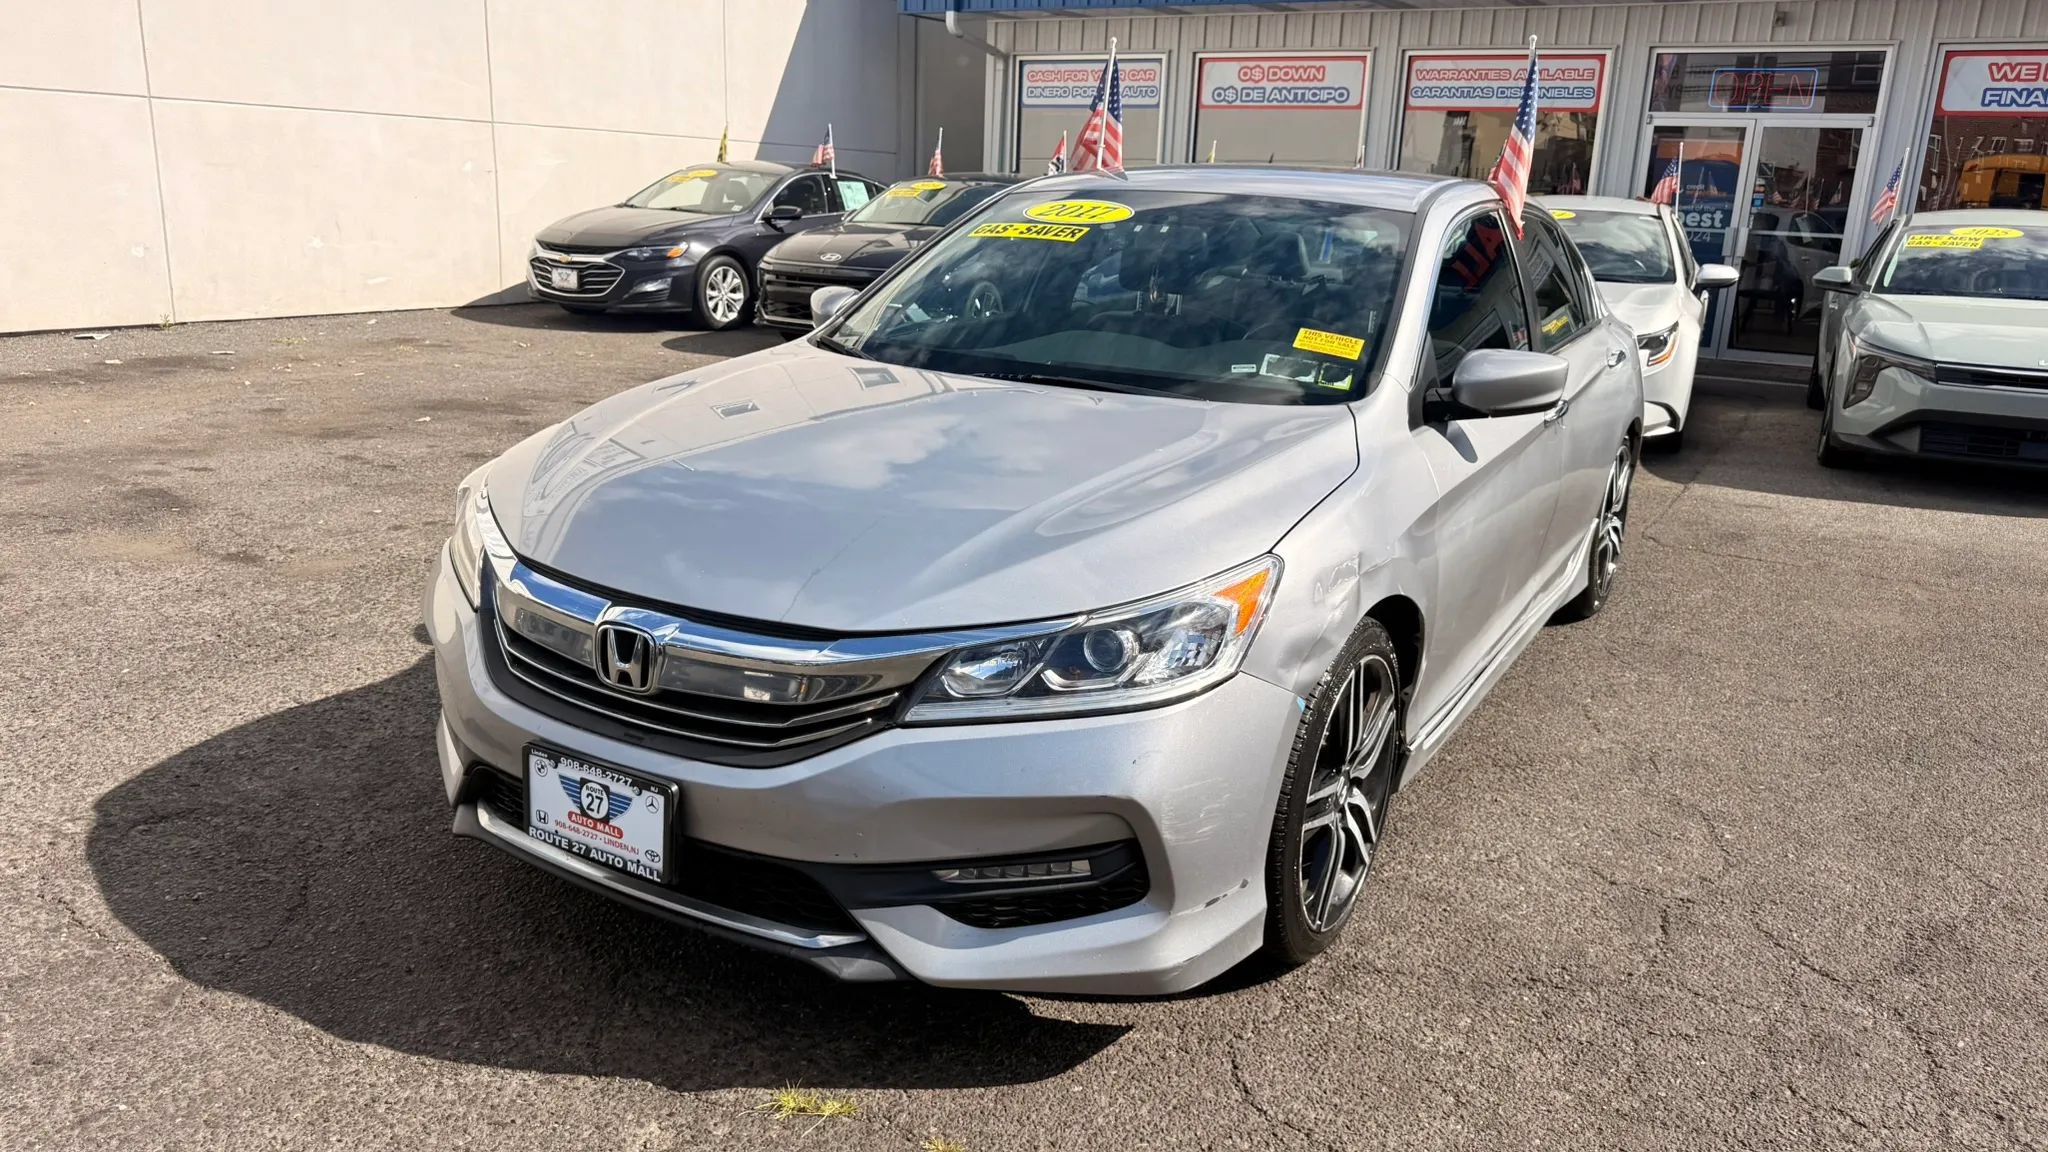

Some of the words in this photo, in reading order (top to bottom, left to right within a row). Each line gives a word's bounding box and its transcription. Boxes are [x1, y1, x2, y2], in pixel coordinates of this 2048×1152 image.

[1028, 70, 1060, 82] CASH
[1063, 70, 1089, 82] FOR
[1091, 70, 1126, 82] YR
[1128, 69, 1156, 81] CAR
[1267, 65, 1325, 82] DOWN
[1416, 68, 1511, 81] WARRANTIES
[1988, 62, 2042, 82] WE
[1027, 86, 1070, 97] DINERO
[1072, 86, 1097, 97] POR
[1121, 86, 1158, 97] AUTO
[1240, 87, 1266, 102] DE
[1267, 87, 1350, 103] ANTICIPO
[1411, 86, 1494, 99] GARANTIAS
[1496, 86, 1596, 99] DISNIBLES
[1714, 72, 1814, 105] OPEN
[1981, 88, 2048, 107] FINA
[1036, 204, 1119, 219] 2017
[1304, 330, 1322, 338] THIS
[1325, 333, 1359, 345] VEHICLE
[1338, 341, 1355, 349] SALE
[560, 757, 633, 787] 908-648-2727
[585, 784, 604, 796] ROUTE
[586, 792, 604, 814] 27
[554, 819, 598, 840] 908-648-2727
[571, 812, 594, 827] AUTO
[596, 822, 620, 837] MALL
[529, 826, 569, 849] ROUTE
[572, 840, 587, 855] 27
[590, 848, 624, 868] AUTO
[627, 860, 662, 882] MALL
